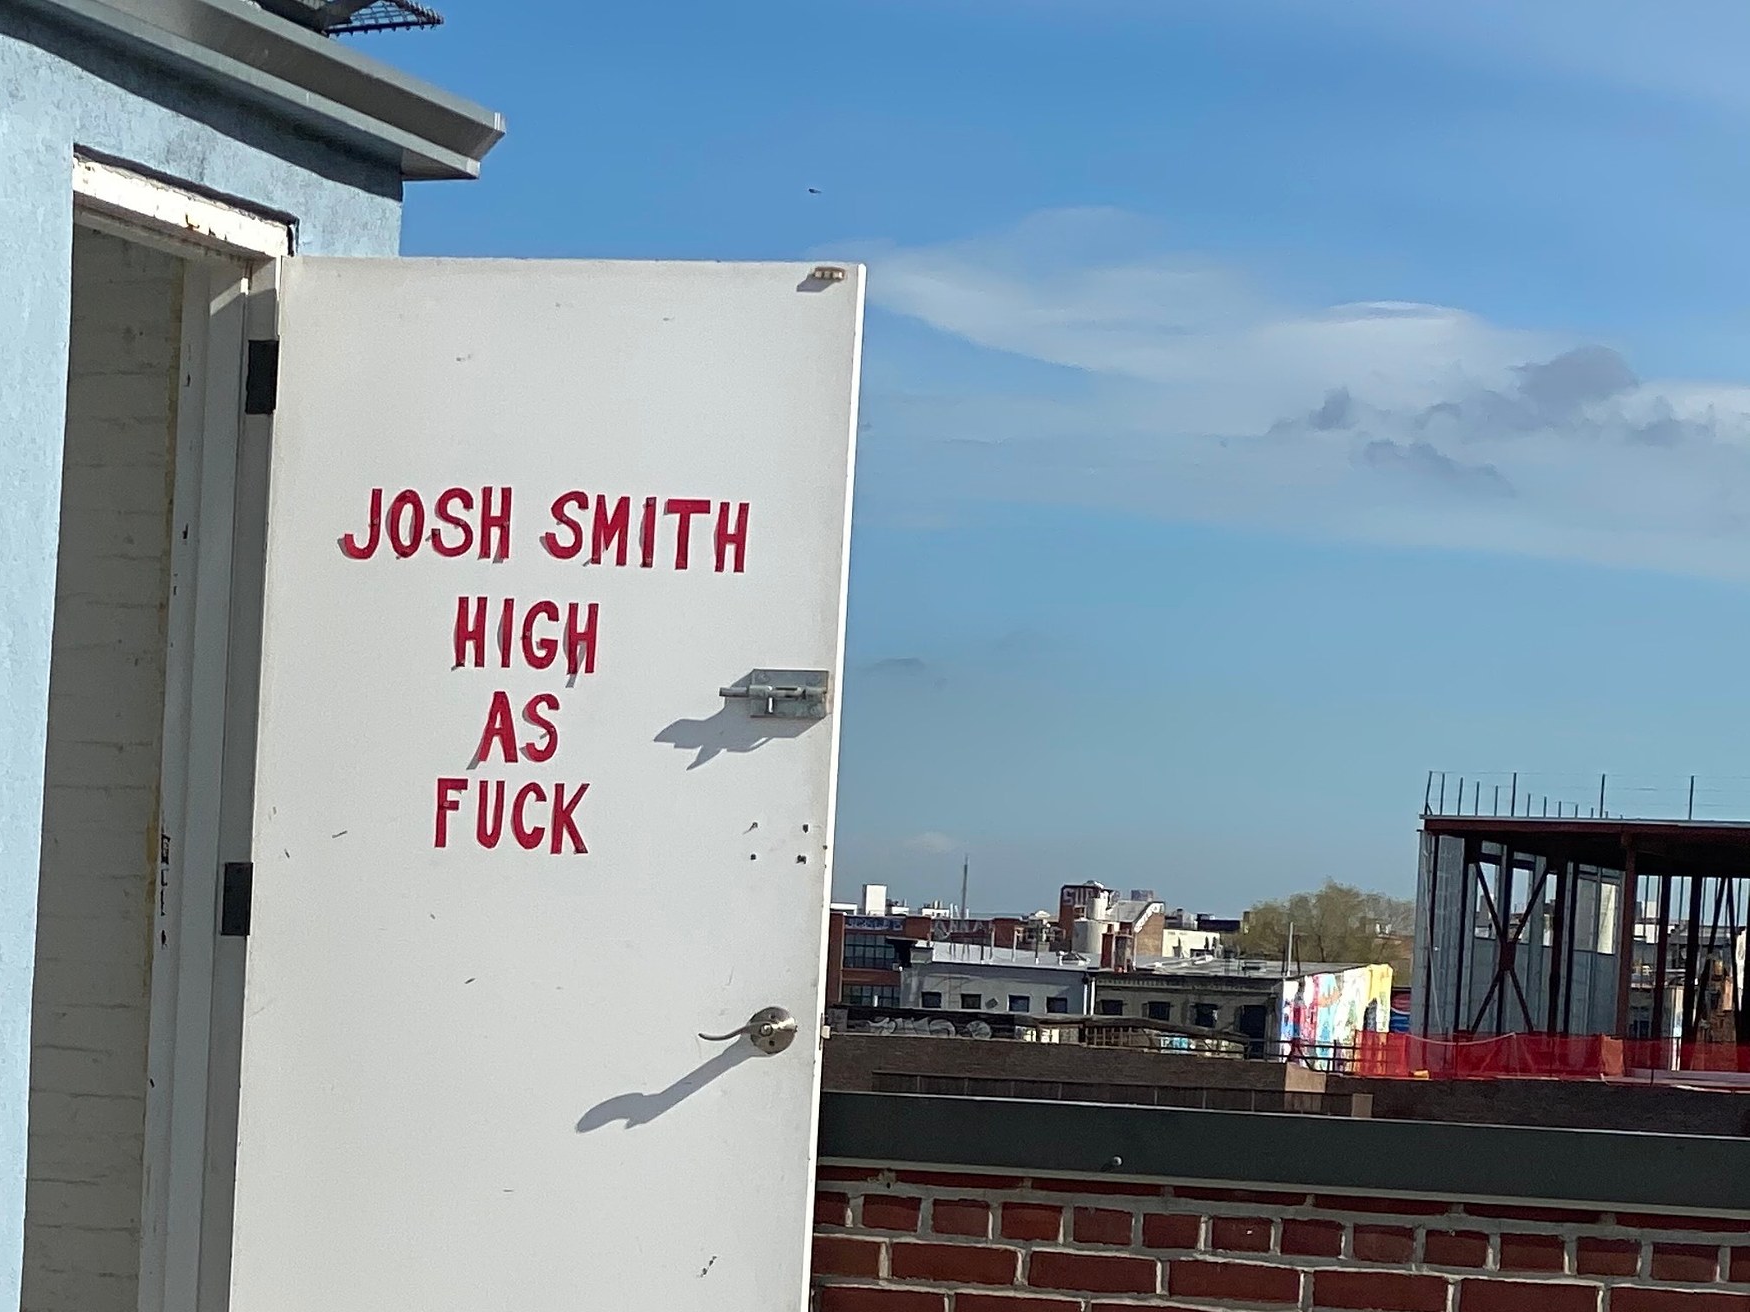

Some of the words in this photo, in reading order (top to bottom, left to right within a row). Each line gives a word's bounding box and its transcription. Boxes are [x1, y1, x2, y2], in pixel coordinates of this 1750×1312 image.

[341, 486, 512, 561] JOSH
[543, 490, 750, 573] SMITH
[453, 596, 599, 676] HIGH
[477, 690, 560, 763] AS
[434, 777, 590, 855] FUCK
